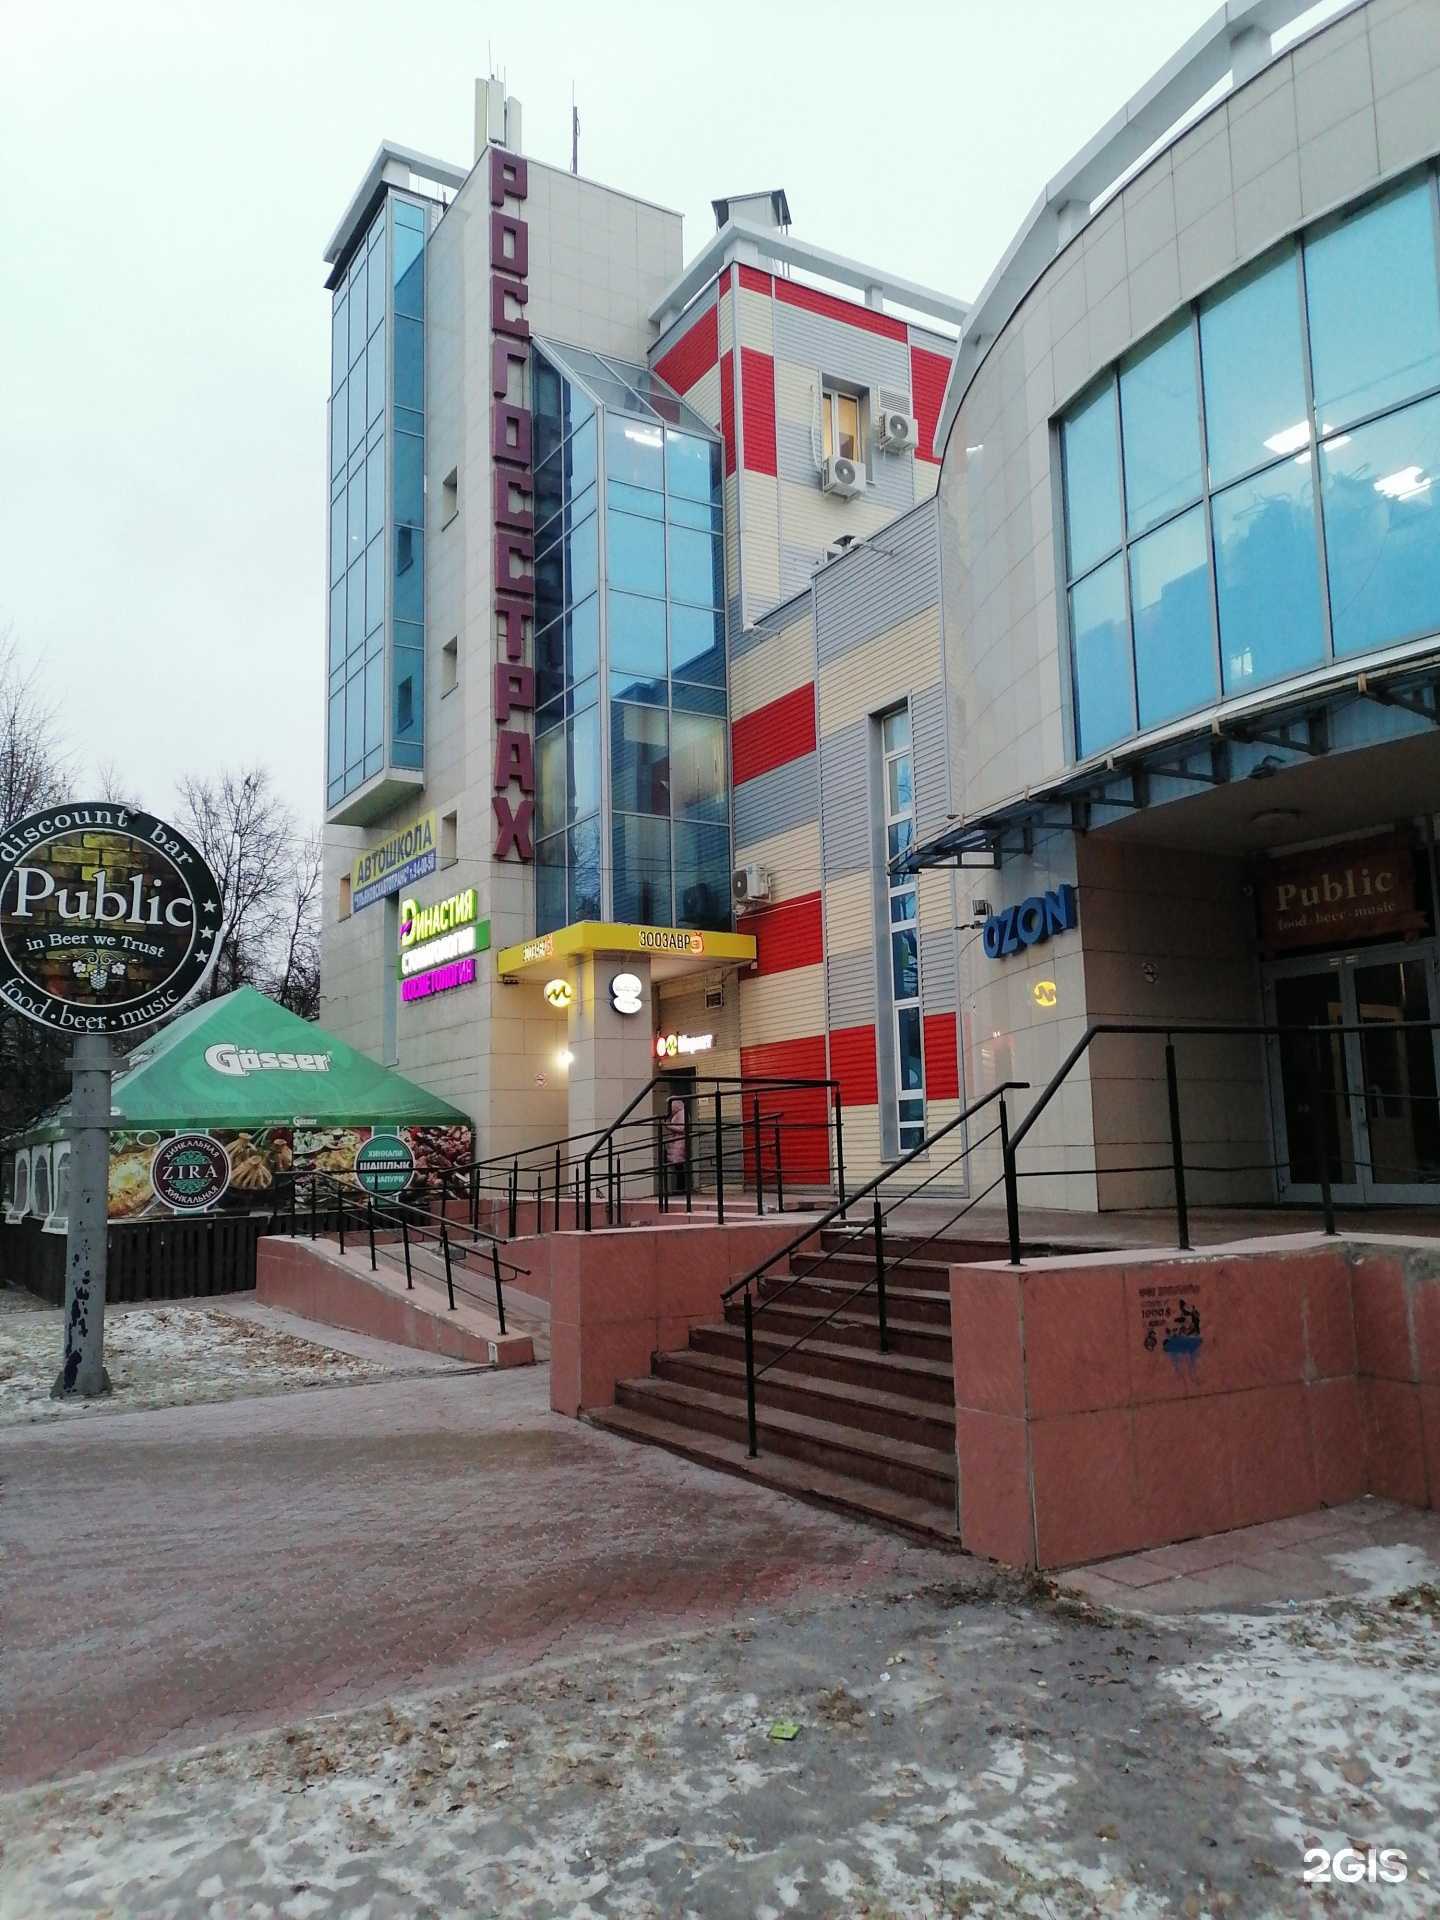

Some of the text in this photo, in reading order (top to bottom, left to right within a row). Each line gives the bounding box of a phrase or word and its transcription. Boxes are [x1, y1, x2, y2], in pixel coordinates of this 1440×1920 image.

[489, 147, 534, 863] РОСГОССТРАХ
[1, 808, 193, 865] discount bar
[357, 819, 432, 886] АВТОШКОЛА
[11, 866, 194, 927] Public
[1276, 868, 1394, 912] Public
[640, 931, 690, 949] ЗООЗАВР
[983, 883, 1077, 959] OZON
[26, 933, 165, 958] in Beer we Trust
[1, 977, 180, 1031] food beer music
[204, 1043, 330, 1076] Gösser
[164, 1139, 220, 1160] ХИНКАЛЬНАЯ
[360, 1161, 410, 1170] ШАШЛЫК
[162, 1165, 218, 1180] ZIRA
[164, 1185, 219, 1205] ХИНКАЛЬНАЯ
